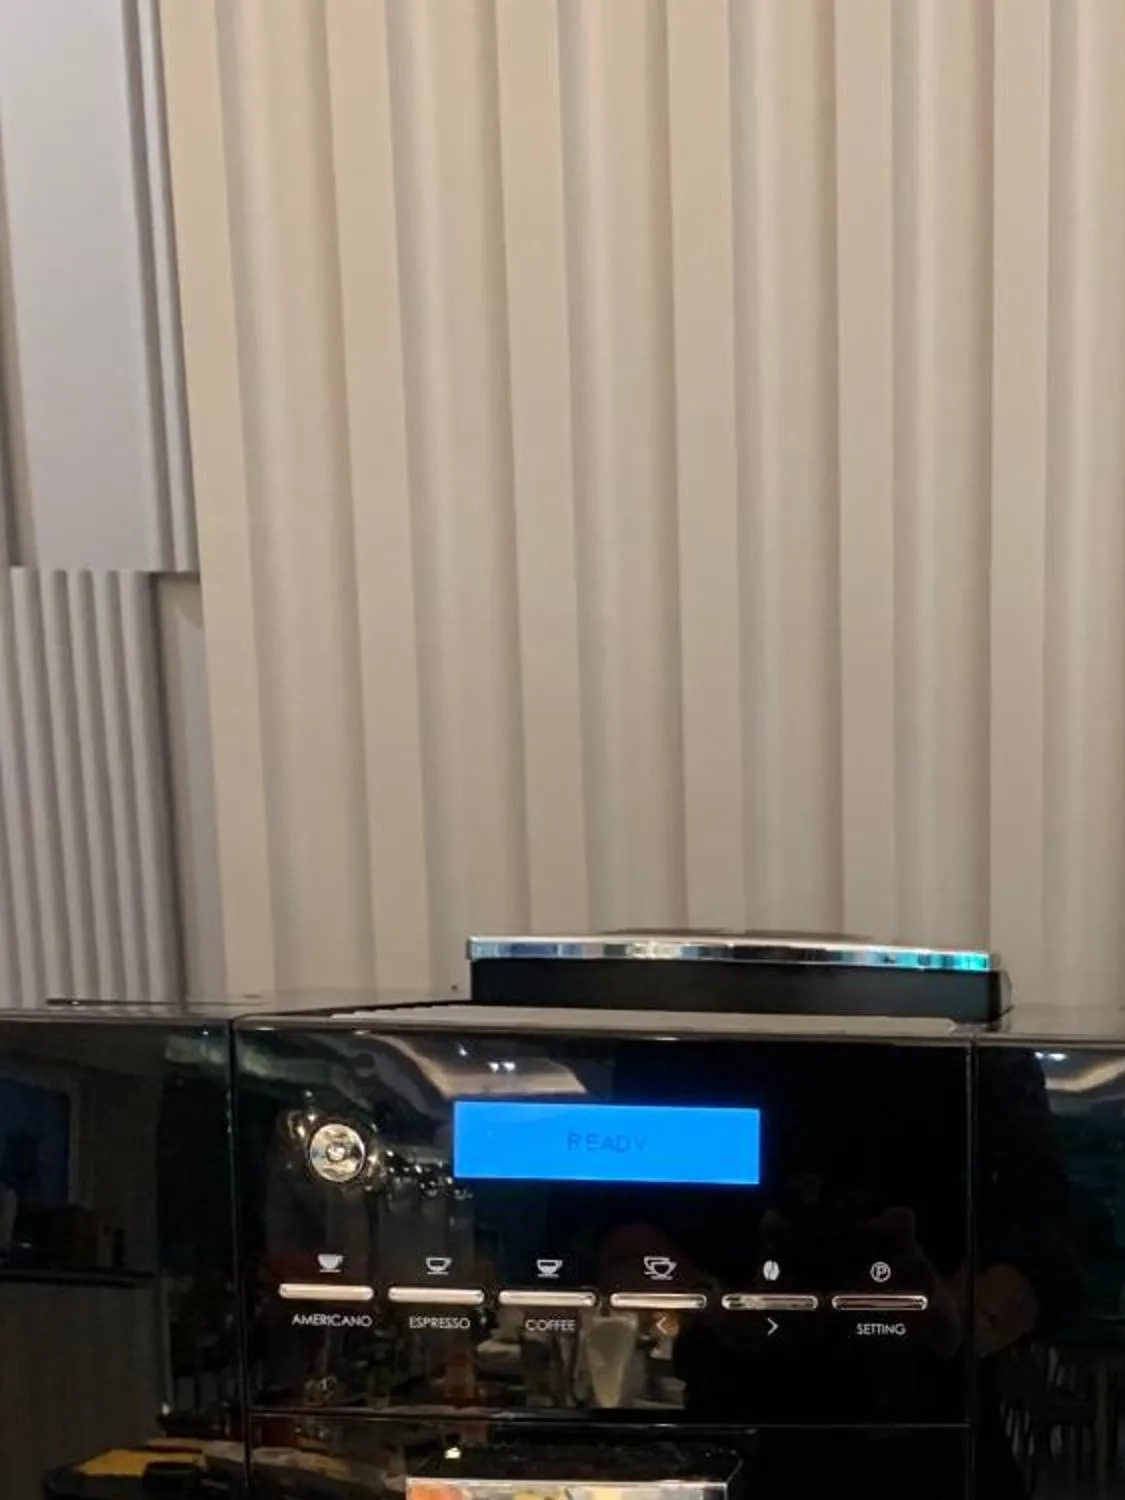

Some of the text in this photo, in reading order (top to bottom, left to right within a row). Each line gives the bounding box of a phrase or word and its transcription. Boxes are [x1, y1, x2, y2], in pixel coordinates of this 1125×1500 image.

[567, 1131, 647, 1154] READY
[291, 1313, 372, 1328] AMERICANO
[409, 1315, 470, 1331] ESPRESSO
[525, 1318, 576, 1332] COFFEE
[856, 1322, 906, 1335] SETTING
